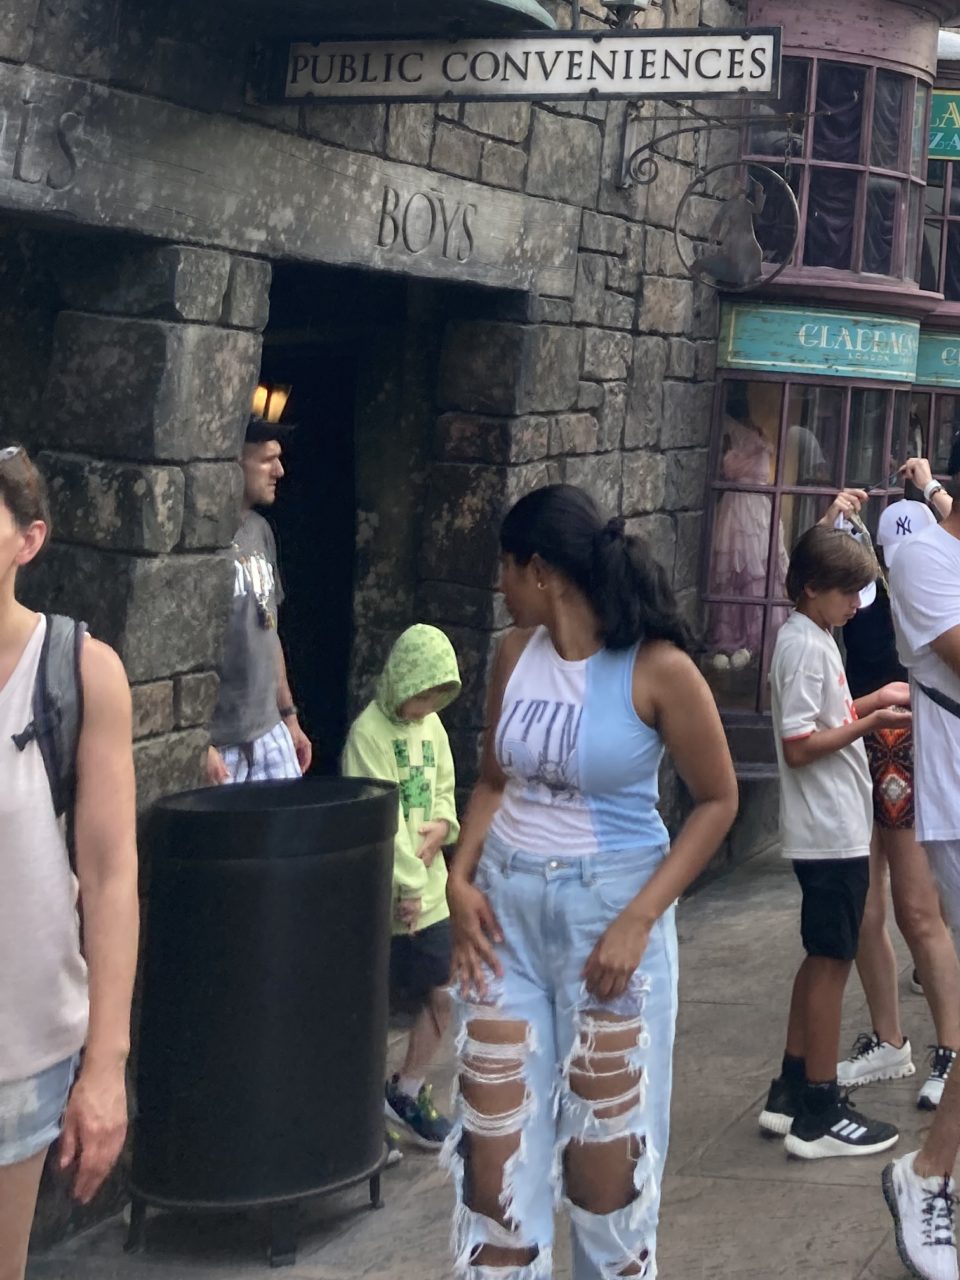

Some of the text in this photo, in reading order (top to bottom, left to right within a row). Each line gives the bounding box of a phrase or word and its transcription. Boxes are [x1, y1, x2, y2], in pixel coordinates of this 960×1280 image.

[289, 46, 767, 86] PUBLIC CONVENIENCES
[374, 185, 478, 263] BOYS
